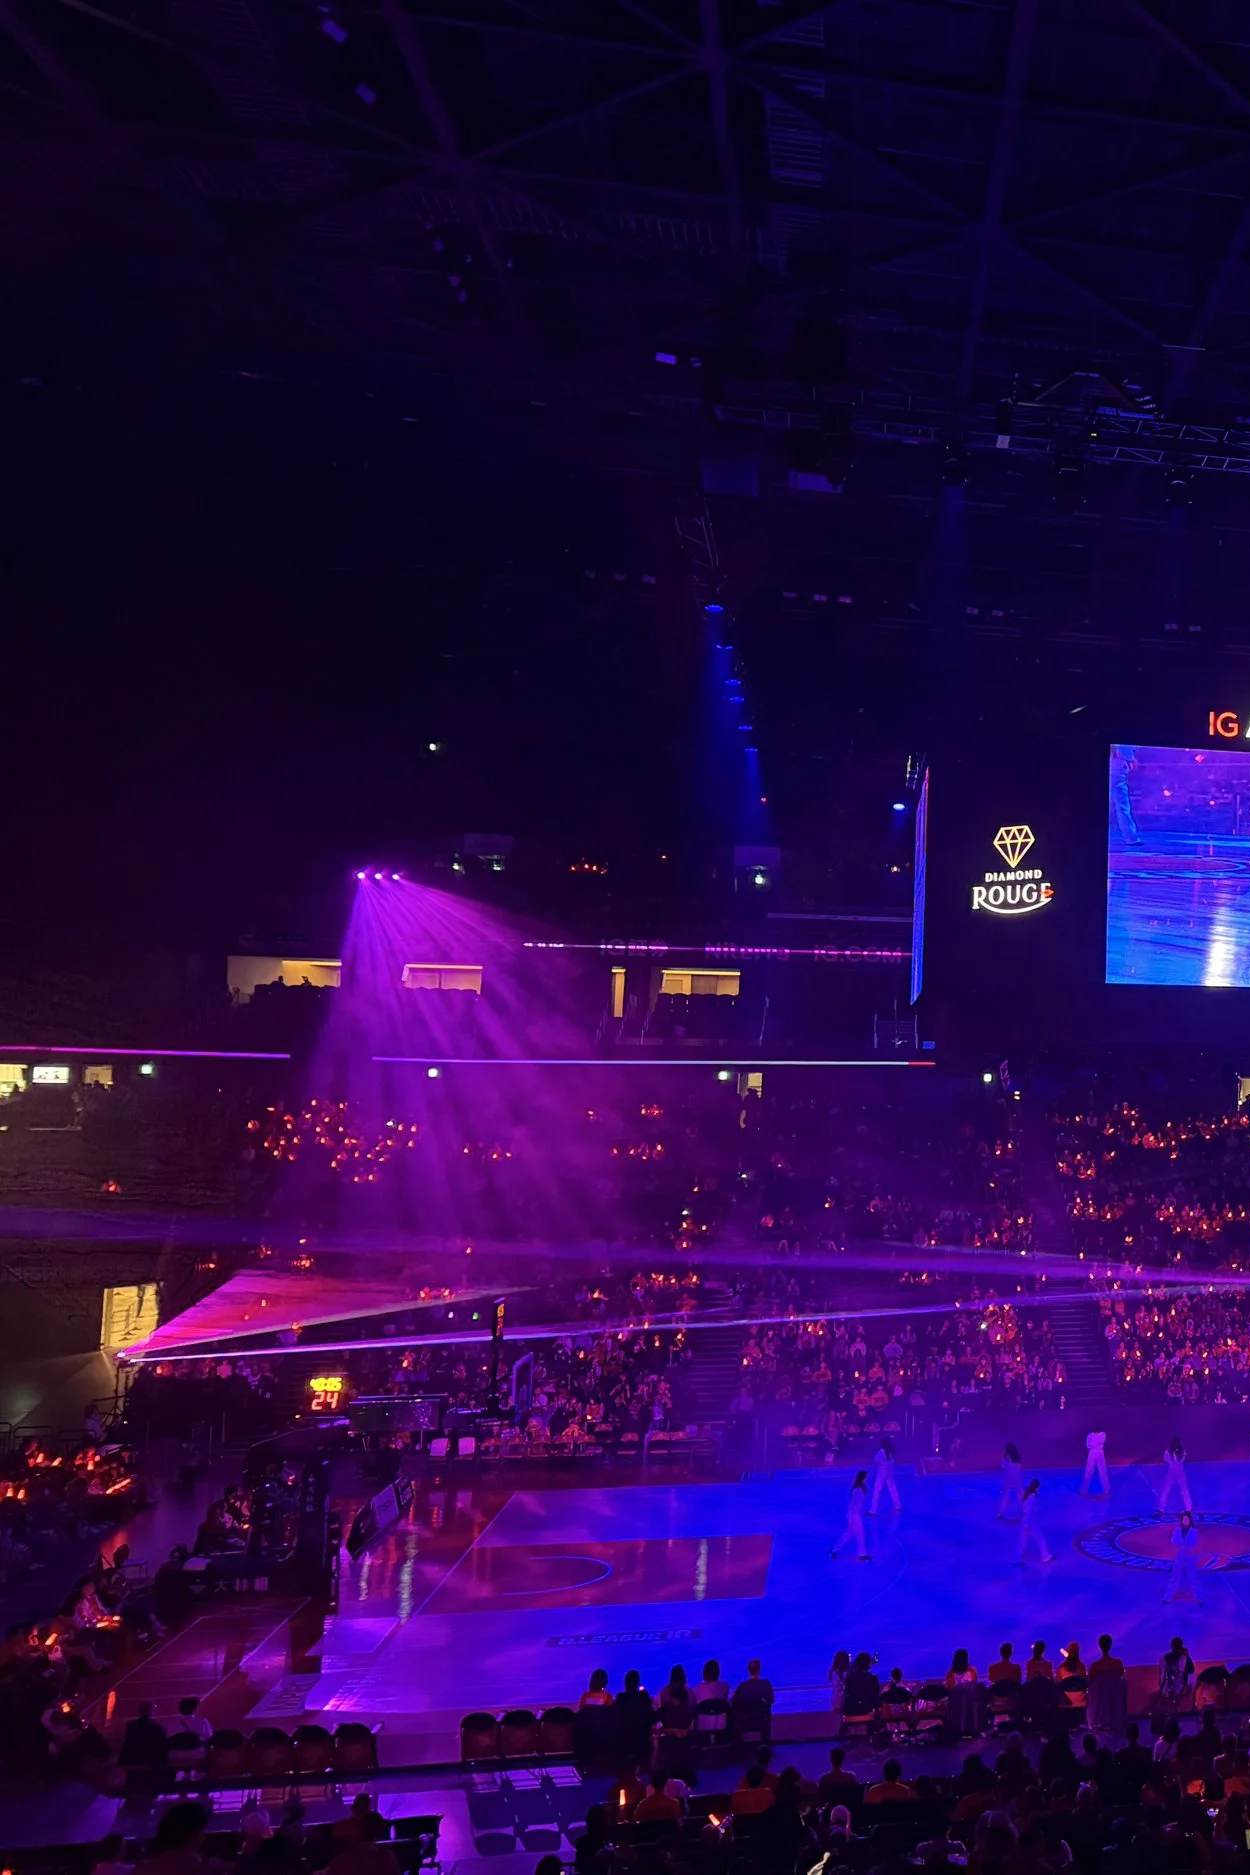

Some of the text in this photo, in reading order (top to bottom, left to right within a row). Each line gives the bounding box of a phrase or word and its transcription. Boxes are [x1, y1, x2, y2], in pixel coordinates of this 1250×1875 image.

[1208, 711, 1239, 738] IG
[984, 869, 1043, 882] DIAMOND
[972, 882, 1054, 913] ROUGE
[311, 1392, 339, 1410] 24
